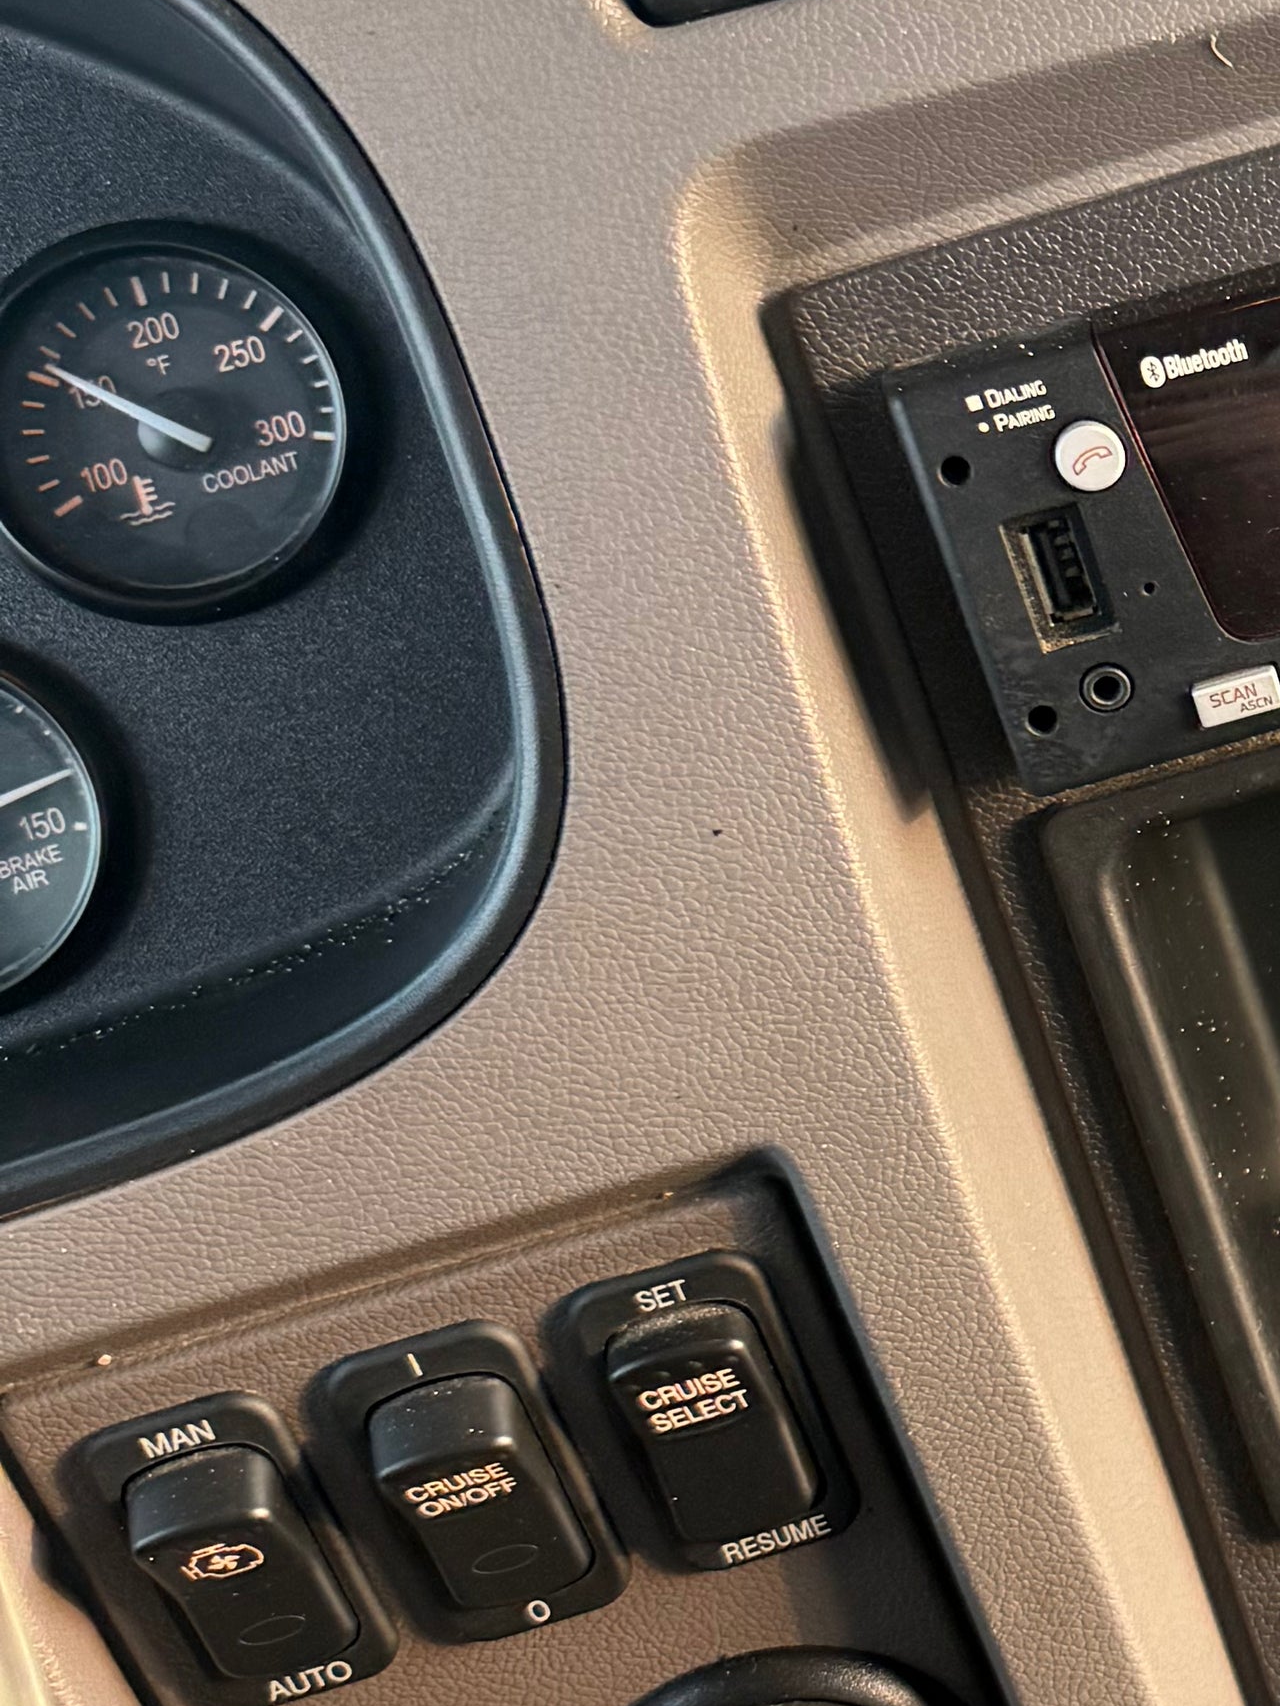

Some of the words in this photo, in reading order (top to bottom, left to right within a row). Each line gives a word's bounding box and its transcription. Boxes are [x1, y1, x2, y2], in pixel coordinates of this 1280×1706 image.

[127, 312, 180, 349] 200
[213, 335, 266, 372] 250
[1163, 339, 1249, 379] Bluetooth
[254, 410, 306, 447] 300
[80, 458, 128, 493] 100
[202, 450, 299, 493] COOLANT
[1208, 683, 1258, 708] SCAN
[1240, 695, 1274, 713] ASCN
[19, 807, 66, 840] 150
[0, 844, 64, 879] BRAKE
[13, 868, 49, 894] AIR
[635, 1279, 688, 1312] SET
[637, 1368, 741, 1412] CRUISE
[650, 1389, 750, 1435] SELECT
[138, 1418, 216, 1460] MAN
[404, 1462, 507, 1505] CRUISE
[416, 1476, 518, 1519] ON/OFF
[721, 1514, 831, 1565] RESUME
[267, 1660, 353, 1704] AUTO
